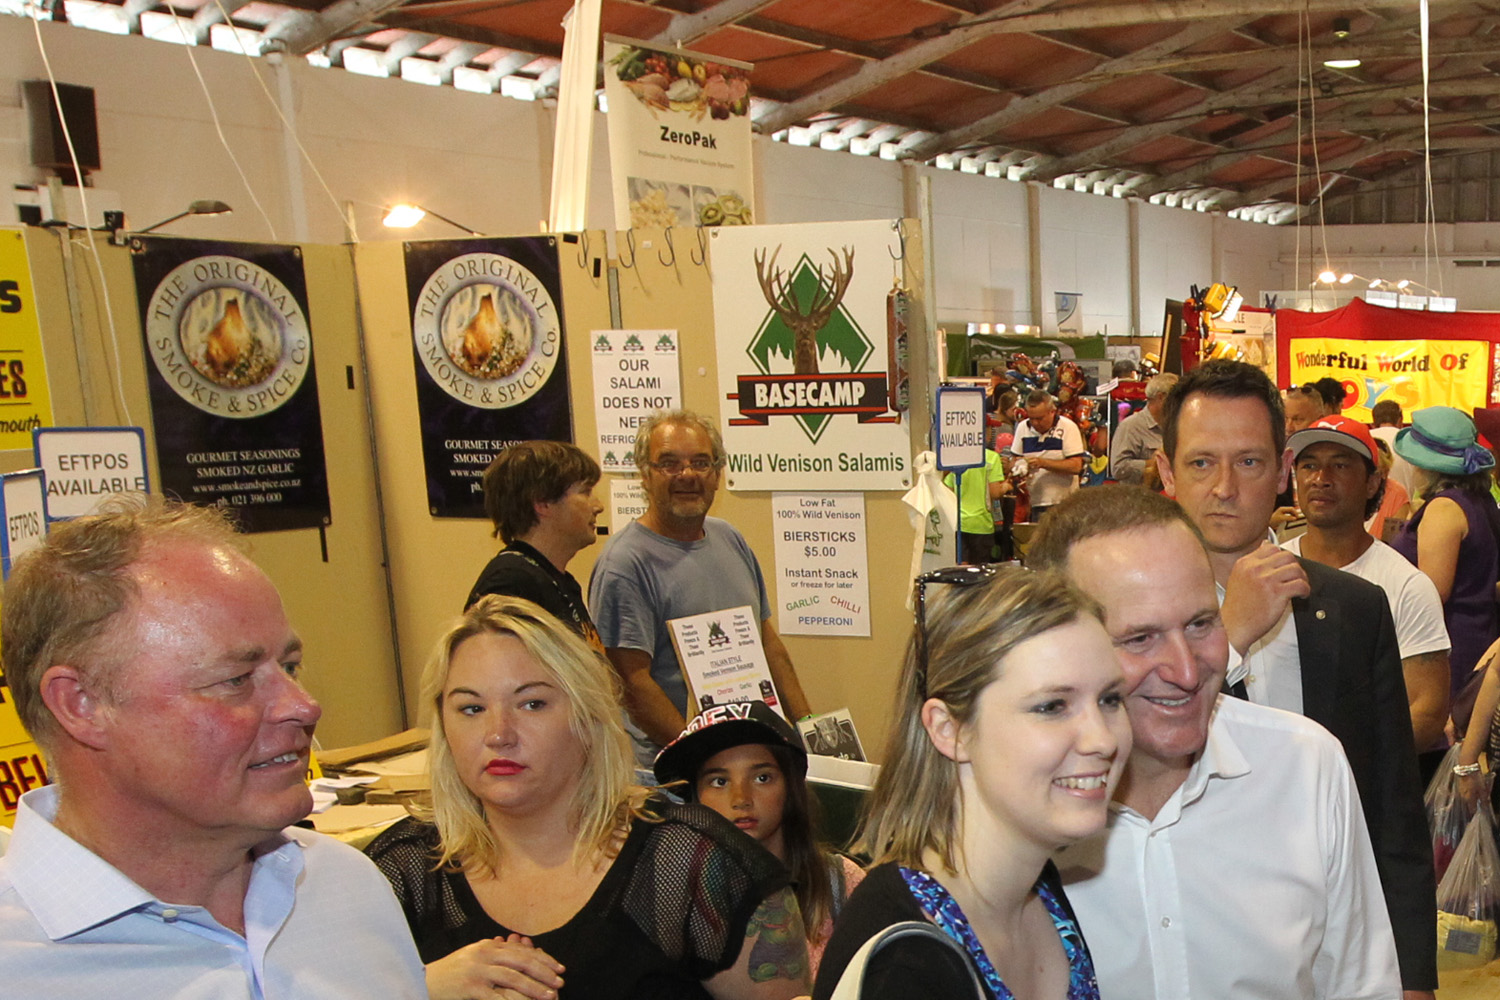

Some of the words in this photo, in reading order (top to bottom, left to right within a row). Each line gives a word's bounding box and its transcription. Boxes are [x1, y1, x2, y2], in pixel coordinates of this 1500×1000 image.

[660, 125, 717, 149] ZeroPak
[155, 275, 188, 321] THE
[193, 262, 298, 326] ORIGINAL
[421, 275, 449, 318] THE
[453, 258, 549, 319] ORIGINAL
[619, 359, 649, 371] OUR
[1296, 349, 1368, 371] Wonderful
[1375, 354, 1430, 372] World
[1440, 353, 1469, 371] Of
[156, 336, 220, 410] SMOKE
[227, 396, 242, 413] &
[246, 369, 297, 412] SPICE
[422, 333, 475, 400] SMOKE
[480, 387, 493, 404] &
[498, 361, 546, 405] SPICE
[610, 377, 661, 389] SALAMI
[755, 381, 865, 407] BASECAMP
[1341, 377, 1422, 410] OYS
[603, 397, 639, 409] DOES
[644, 397, 672, 408] NOT
[620, 417, 652, 428] NEE
[946, 411, 977, 426] EFTPOS
[445, 440, 489, 449] GOURMET
[940, 432, 984, 448] AVAILABLE
[58, 454, 128, 471] EFTPOS
[186, 451, 238, 464] GOURMET
[239, 448, 301, 461] SEASONINGS
[453, 454, 492, 463] SMOKED
[728, 453, 763, 472] Wild
[767, 452, 832, 472] Venison
[838, 451, 904, 471] Salamis
[197, 466, 240, 478] SMOKED
[242, 465, 256, 475] NZ
[258, 463, 294, 474] GARLIC
[48, 477, 145, 496] AVAILABLE
[193, 478, 301, 492] www.smokeandspice.co.nz
[232, 495, 247, 505] 021
[266, 493, 282, 502] 000
[800, 498, 819, 507] Low
[821, 498, 836, 507] Fat
[777, 510, 801, 519] 100%
[802, 510, 822, 519] Wild
[825, 510, 861, 519] Venison
[9, 511, 39, 542] EFTPOS
[783, 531, 856, 542] BIERSTICKS
[804, 545, 837, 558] $5.00
[785, 567, 823, 578] Instant
[825, 567, 859, 579] Snack
[800, 581, 823, 589] freeze
[824, 581, 835, 589] for
[786, 595, 820, 611] GARLIC
[830, 595, 862, 614] CHILLI
[798, 616, 853, 626] PEPPERONI
